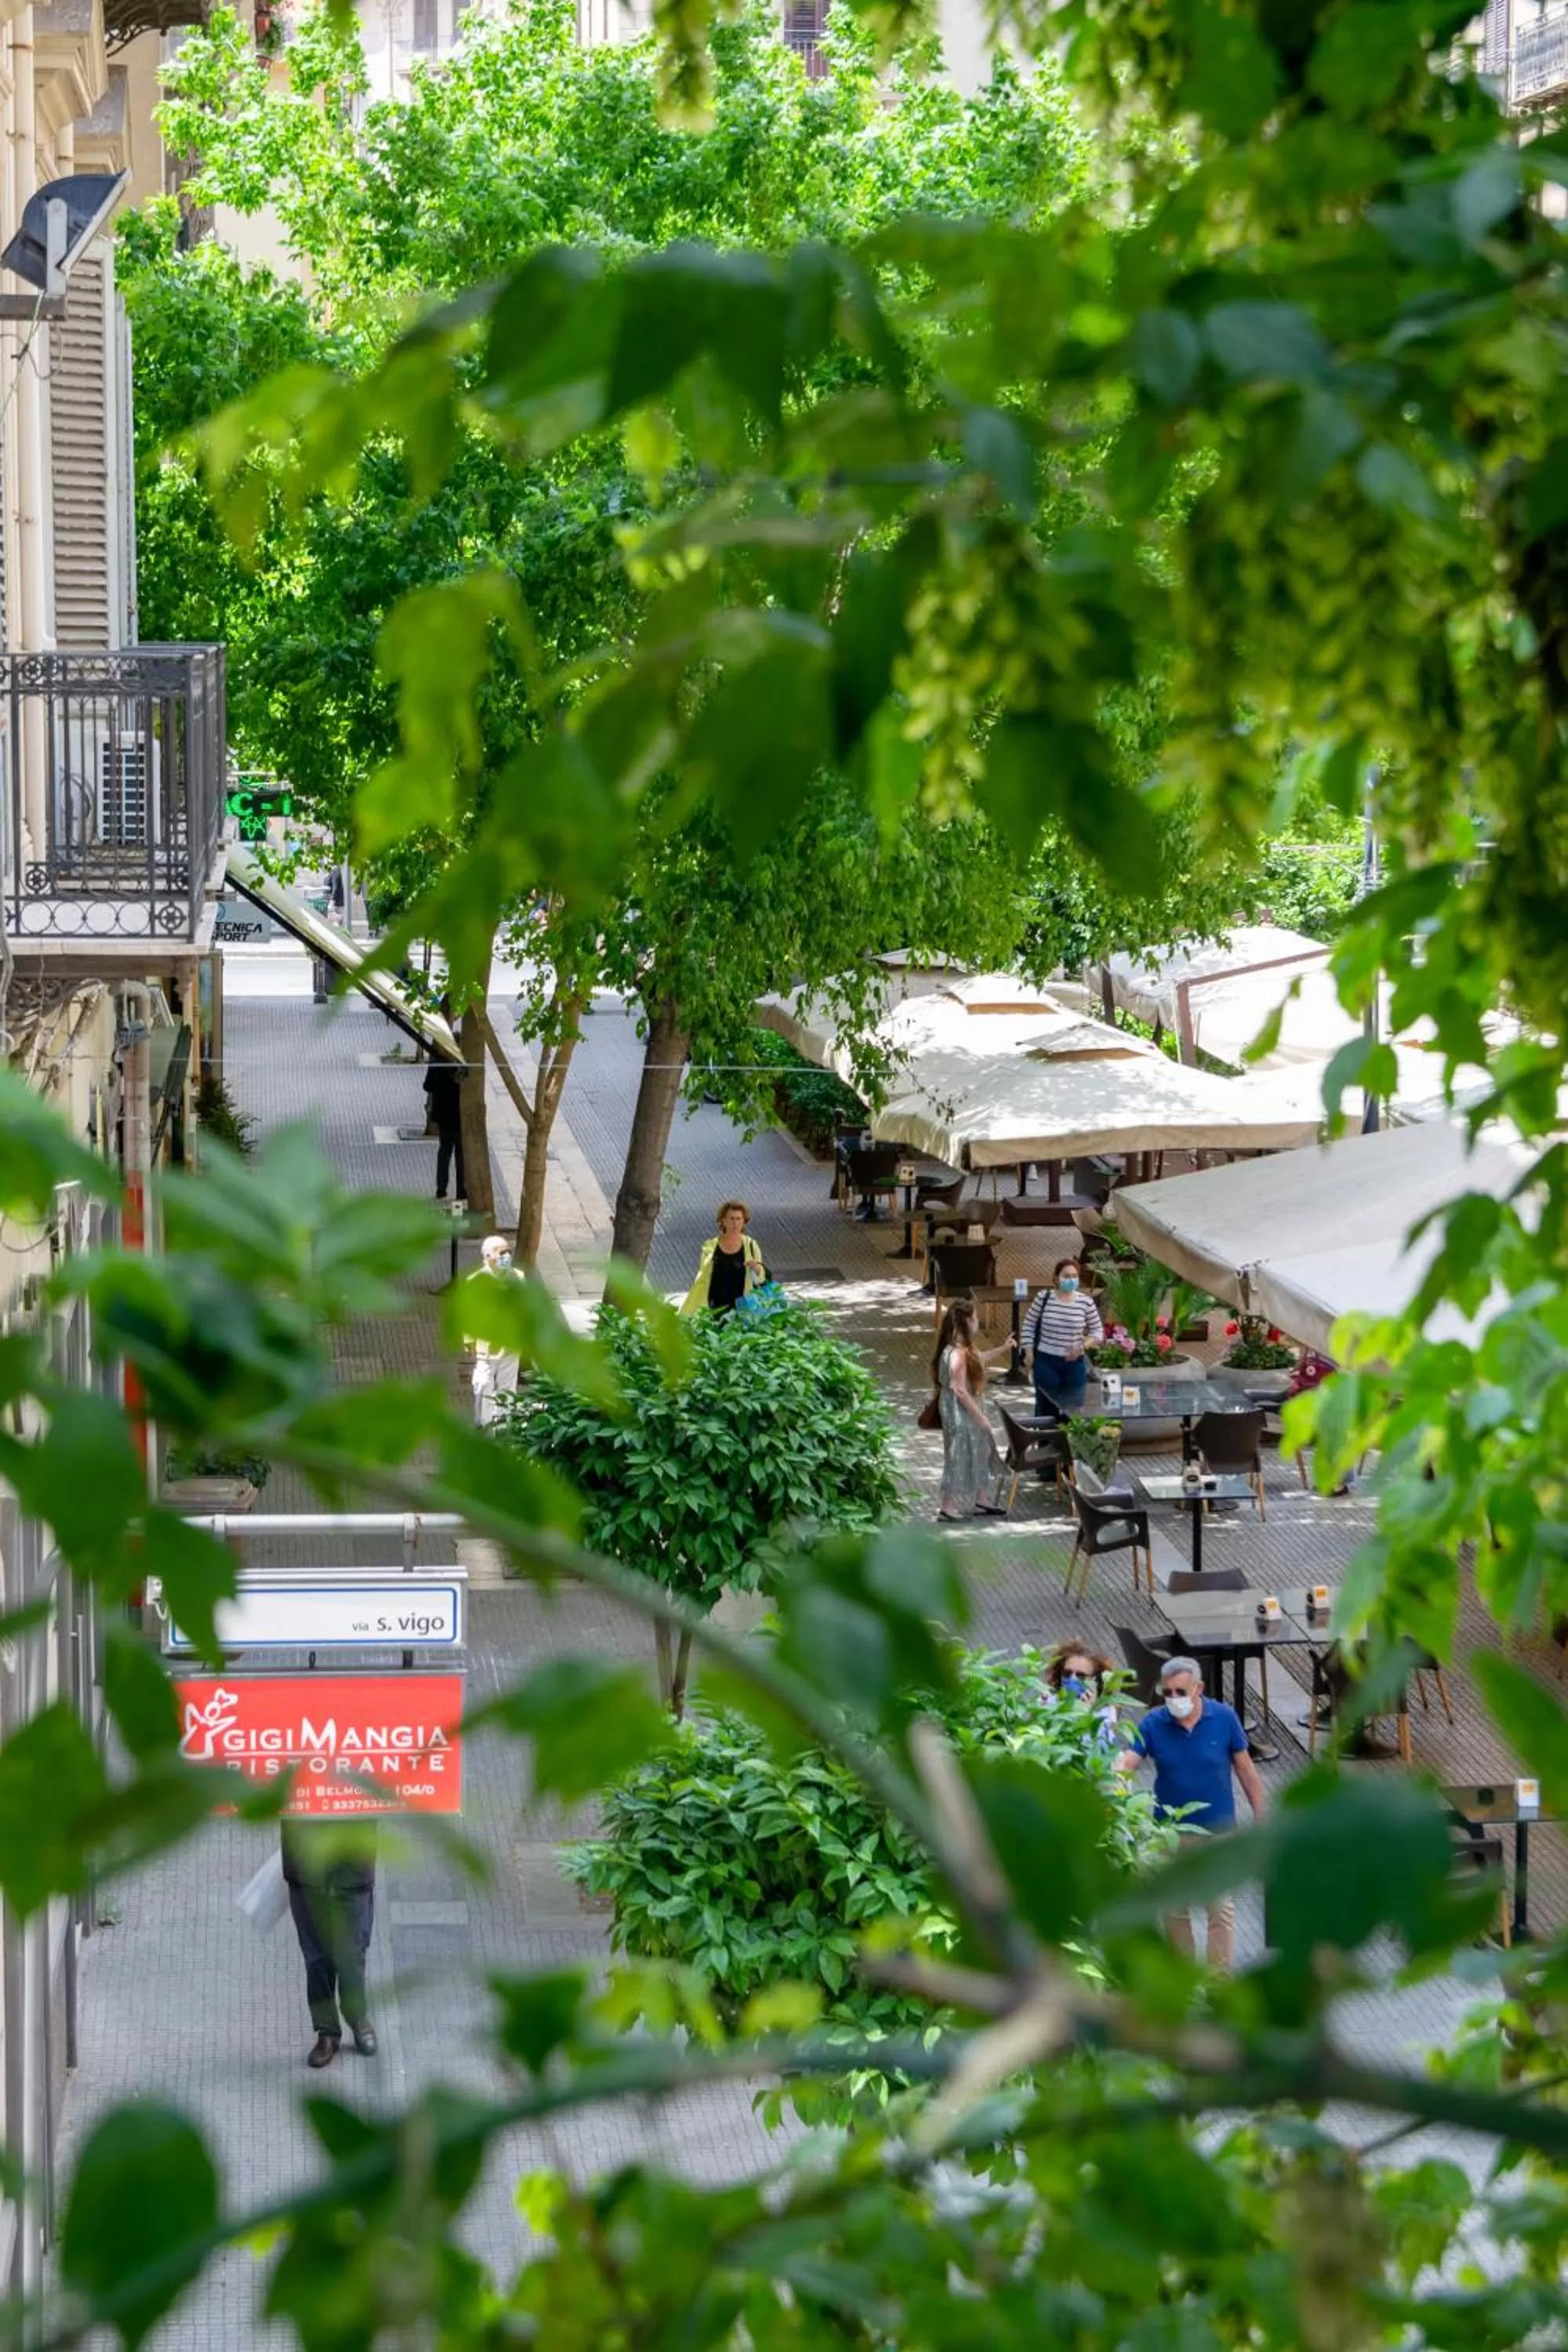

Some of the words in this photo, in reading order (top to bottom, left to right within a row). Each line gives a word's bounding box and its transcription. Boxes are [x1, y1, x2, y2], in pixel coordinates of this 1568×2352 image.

[352, 1622, 369, 1631] via
[397, 1611, 445, 1635] vigo
[223, 1728, 293, 1751] GIGI
[300, 1715, 448, 1757] MANGIA
[316, 1785, 386, 1797] BELMO
